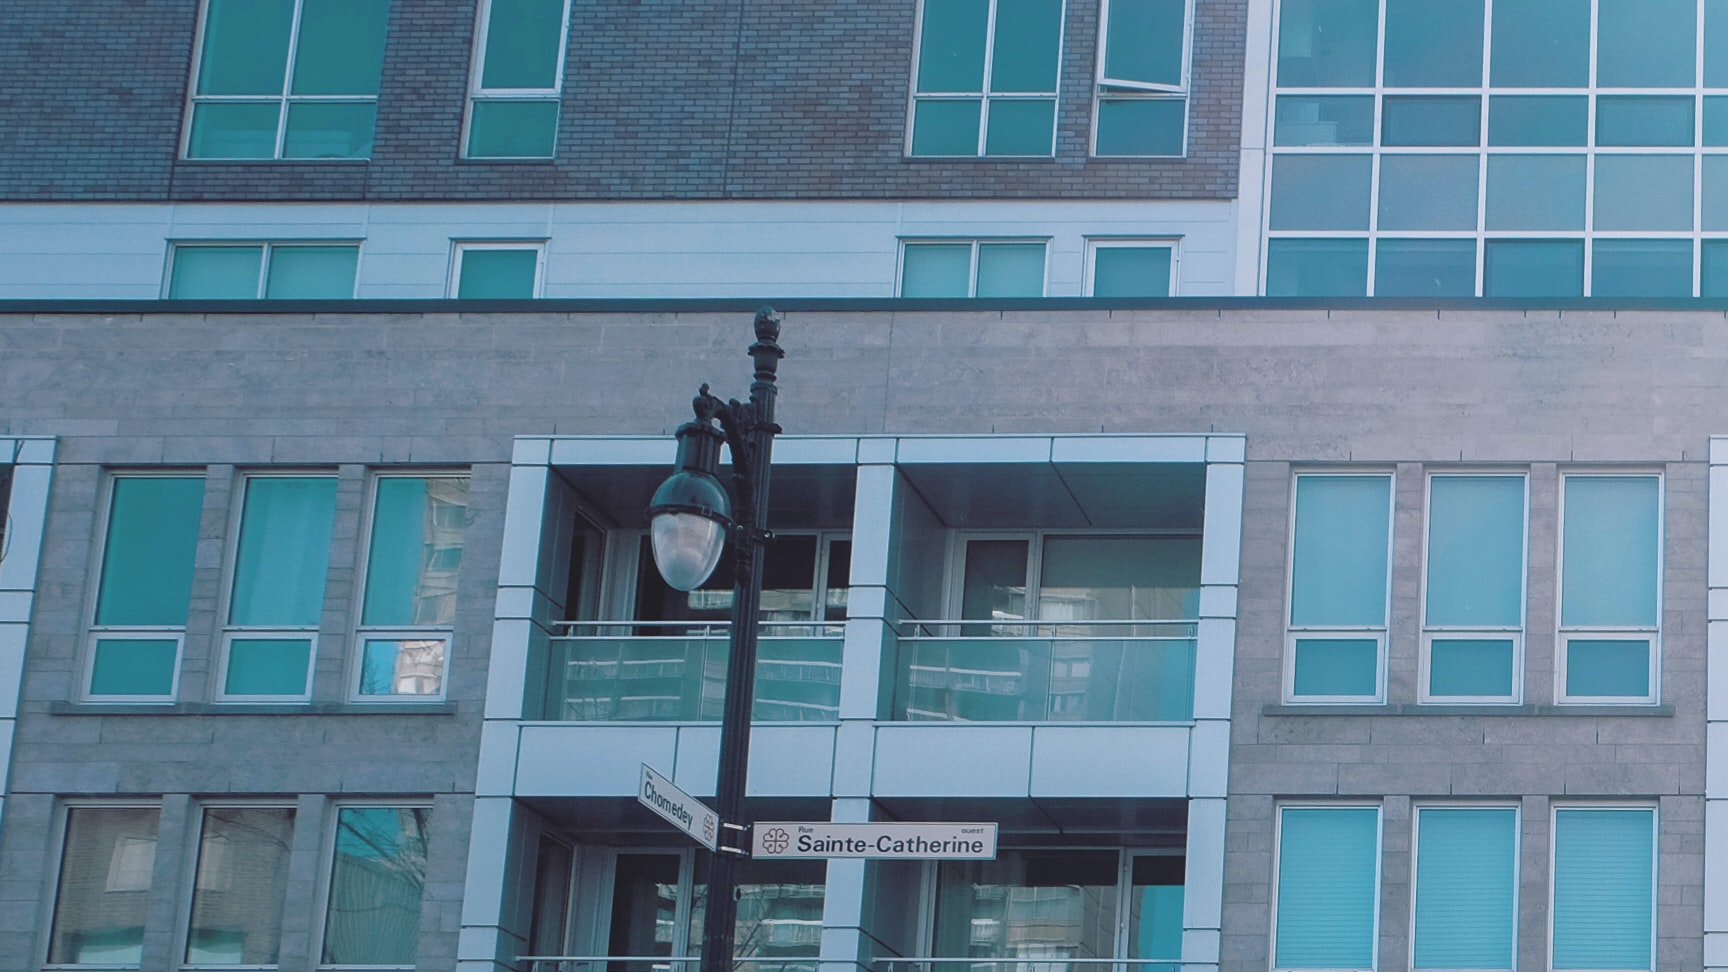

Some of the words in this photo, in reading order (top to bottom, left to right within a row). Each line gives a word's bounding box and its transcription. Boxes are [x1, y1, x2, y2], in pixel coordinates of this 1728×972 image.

[644, 780, 694, 831] Chomedey
[798, 825, 814, 834] Rue
[797, 835, 984, 853] Sainte-Catherine
